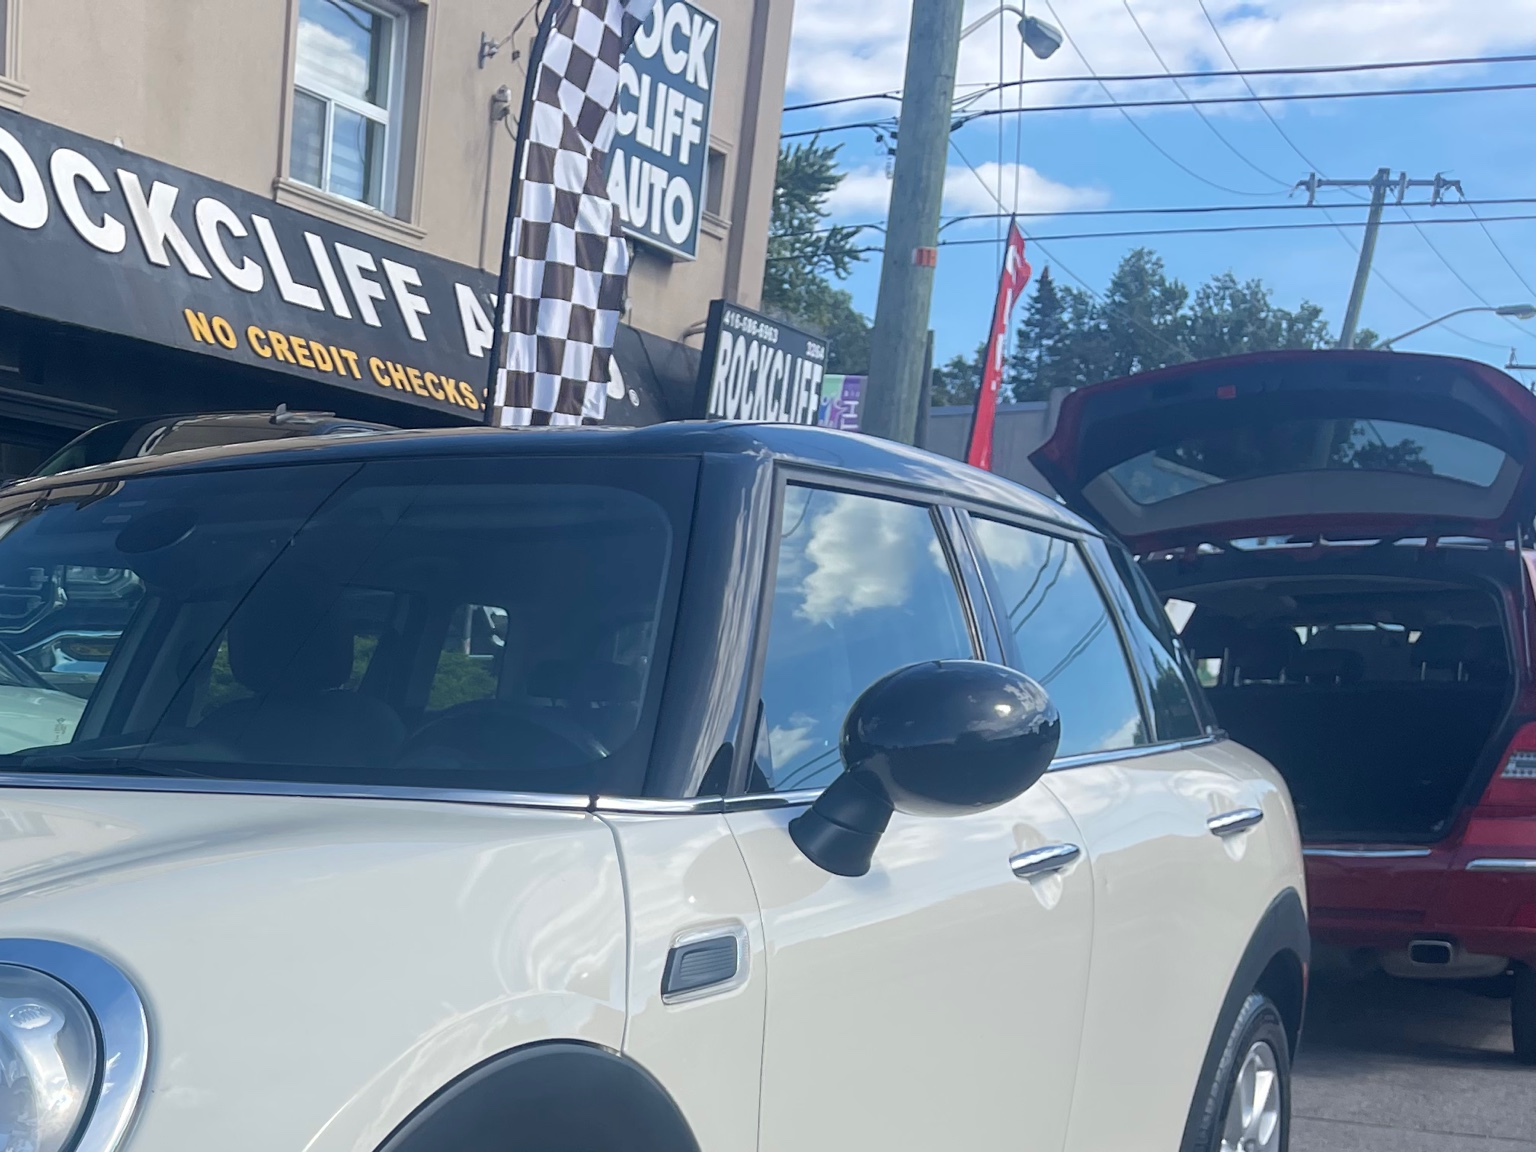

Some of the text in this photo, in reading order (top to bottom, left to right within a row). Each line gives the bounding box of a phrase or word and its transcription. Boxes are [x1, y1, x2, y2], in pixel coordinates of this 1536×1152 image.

[634, 0, 715, 90] OCK
[617, 62, 704, 165] CLIFF
[606, 148, 694, 244] AUTO
[184, 308, 237, 351] NO
[246, 325, 362, 381] CREDIT
[709, 330, 823, 426] ROCKCLIFF
